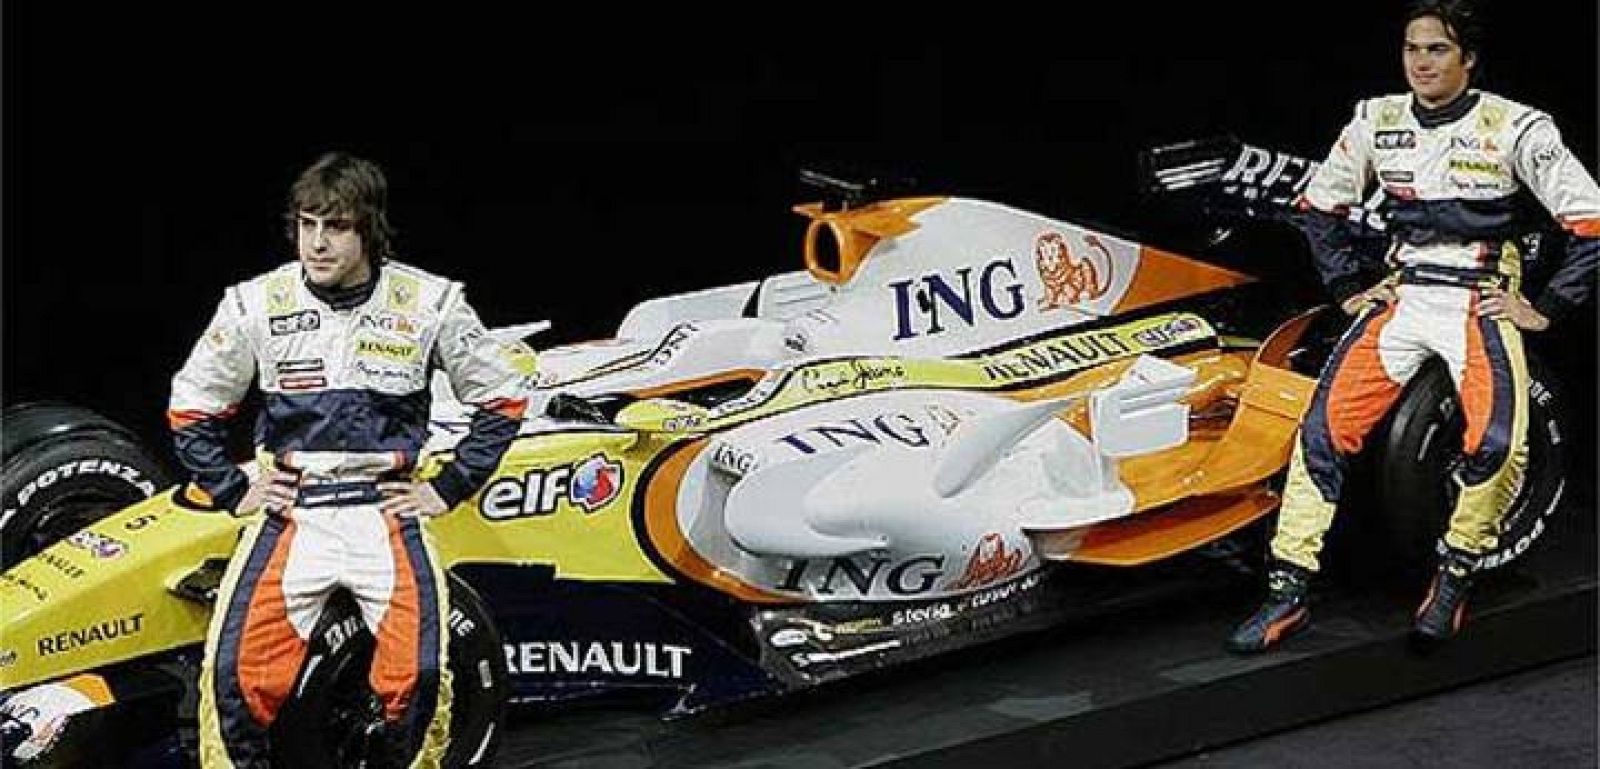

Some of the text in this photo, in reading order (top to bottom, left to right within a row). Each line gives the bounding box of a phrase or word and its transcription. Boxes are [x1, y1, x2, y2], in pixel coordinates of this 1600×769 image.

[888, 257, 1026, 341] ING
[984, 332, 1131, 381] RENAULT
[776, 414, 931, 454] ING
[712, 441, 760, 473] ING
[17, 459, 157, 505] POTENZA
[481, 464, 572, 522] elf
[776, 554, 945, 595] ING
[36, 613, 144, 657] RENAULT
